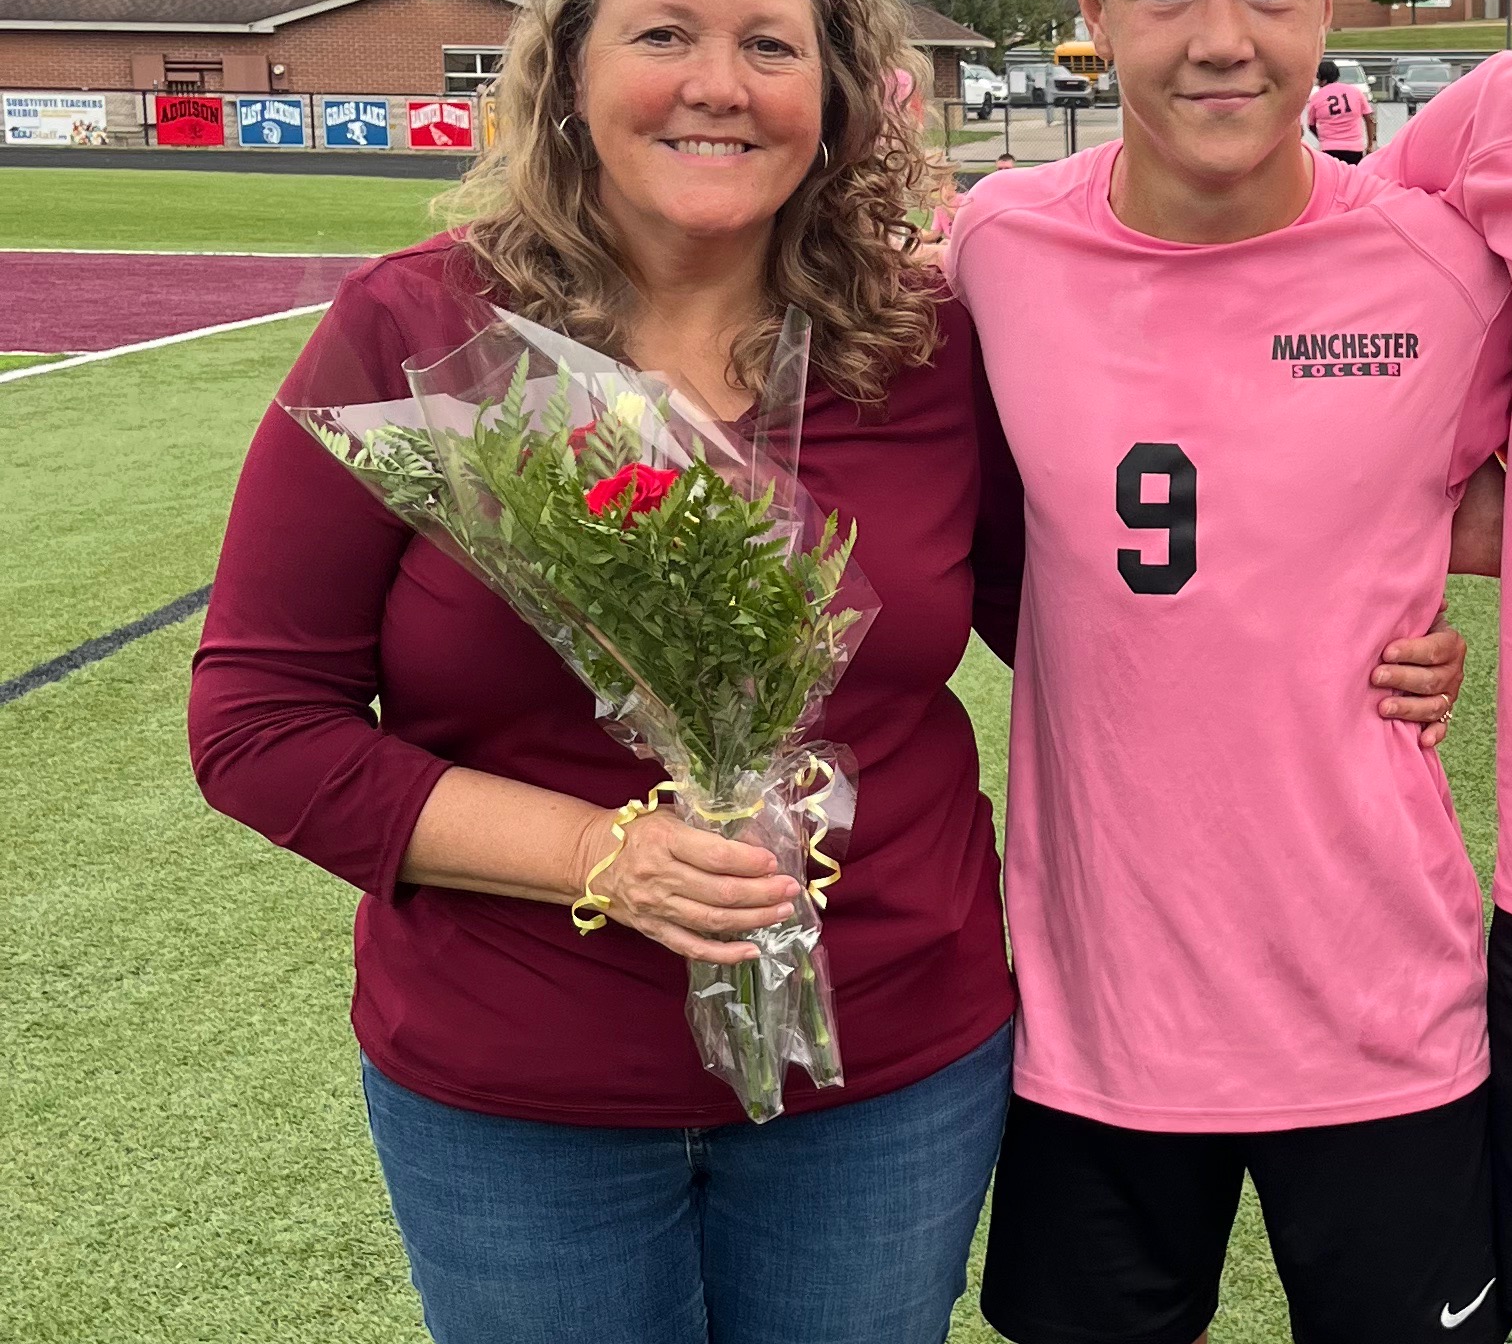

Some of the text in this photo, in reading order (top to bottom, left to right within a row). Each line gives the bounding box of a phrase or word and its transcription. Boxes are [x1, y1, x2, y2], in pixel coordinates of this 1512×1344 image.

[161, 100, 220, 125] ADDISON
[241, 101, 301, 127] EAST JACKSON
[326, 102, 387, 127] GRASS LAKE
[1327, 93, 1352, 115] 21
[1271, 332, 1419, 360] MANCHESTER
[1292, 362, 1401, 378] SOCCER
[1116, 441, 1198, 596] 9
